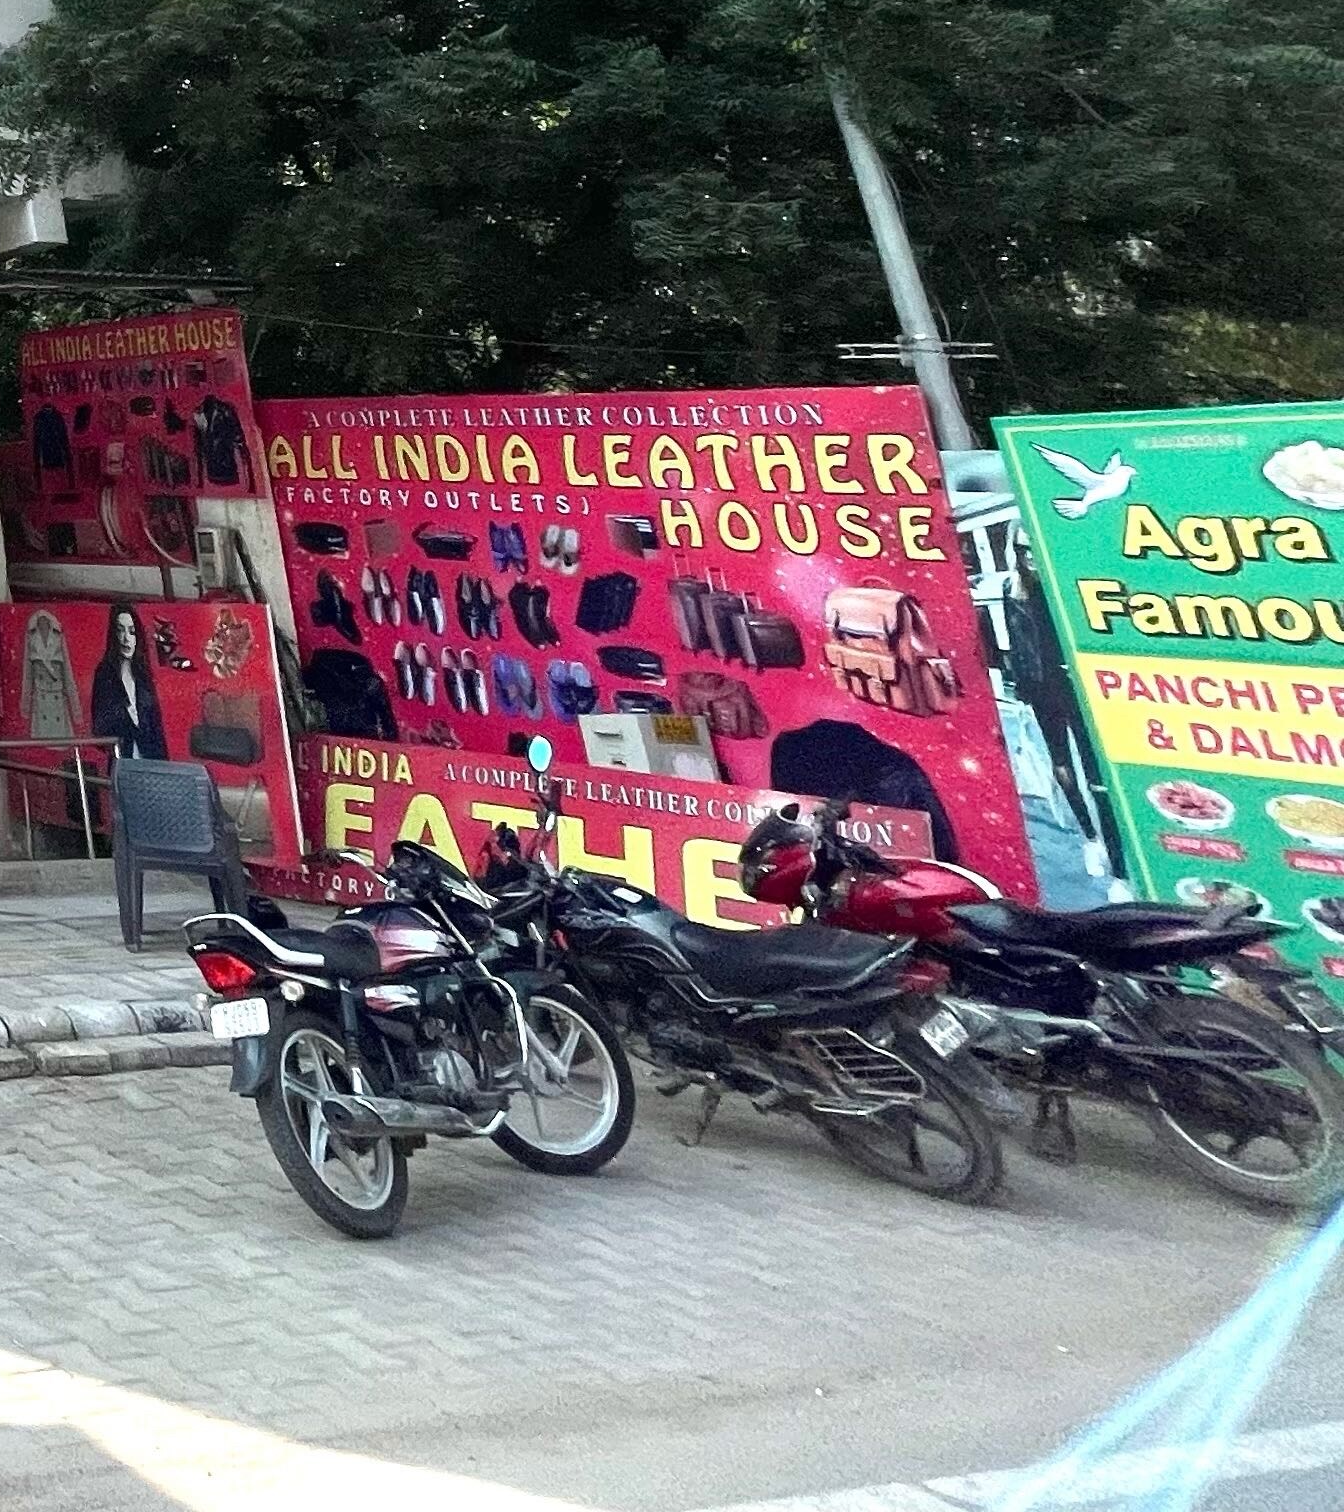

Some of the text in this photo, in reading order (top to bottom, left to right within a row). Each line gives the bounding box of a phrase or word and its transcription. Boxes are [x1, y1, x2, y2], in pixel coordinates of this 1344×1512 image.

[22, 317, 237, 366] ALL INDIA LEATHER HOUSE
[325, 408, 455, 428] COMPLETE
[463, 407, 594, 427] LEATHER
[602, 403, 825, 427] COLLECTION
[267, 433, 929, 495] ALL INDIA LEATHER
[659, 498, 948, 562] HOUSE
[1123, 504, 1331, 574] Agra
[1076, 578, 1344, 645] Famou
[1095, 669, 1280, 713] PANCHI
[1147, 719, 1344, 768] & DALM
[322, 744, 414, 785] INDIA
[444, 762, 457, 781] A
[585, 780, 700, 817] LEATHER
[324, 782, 806, 932] EATHE
